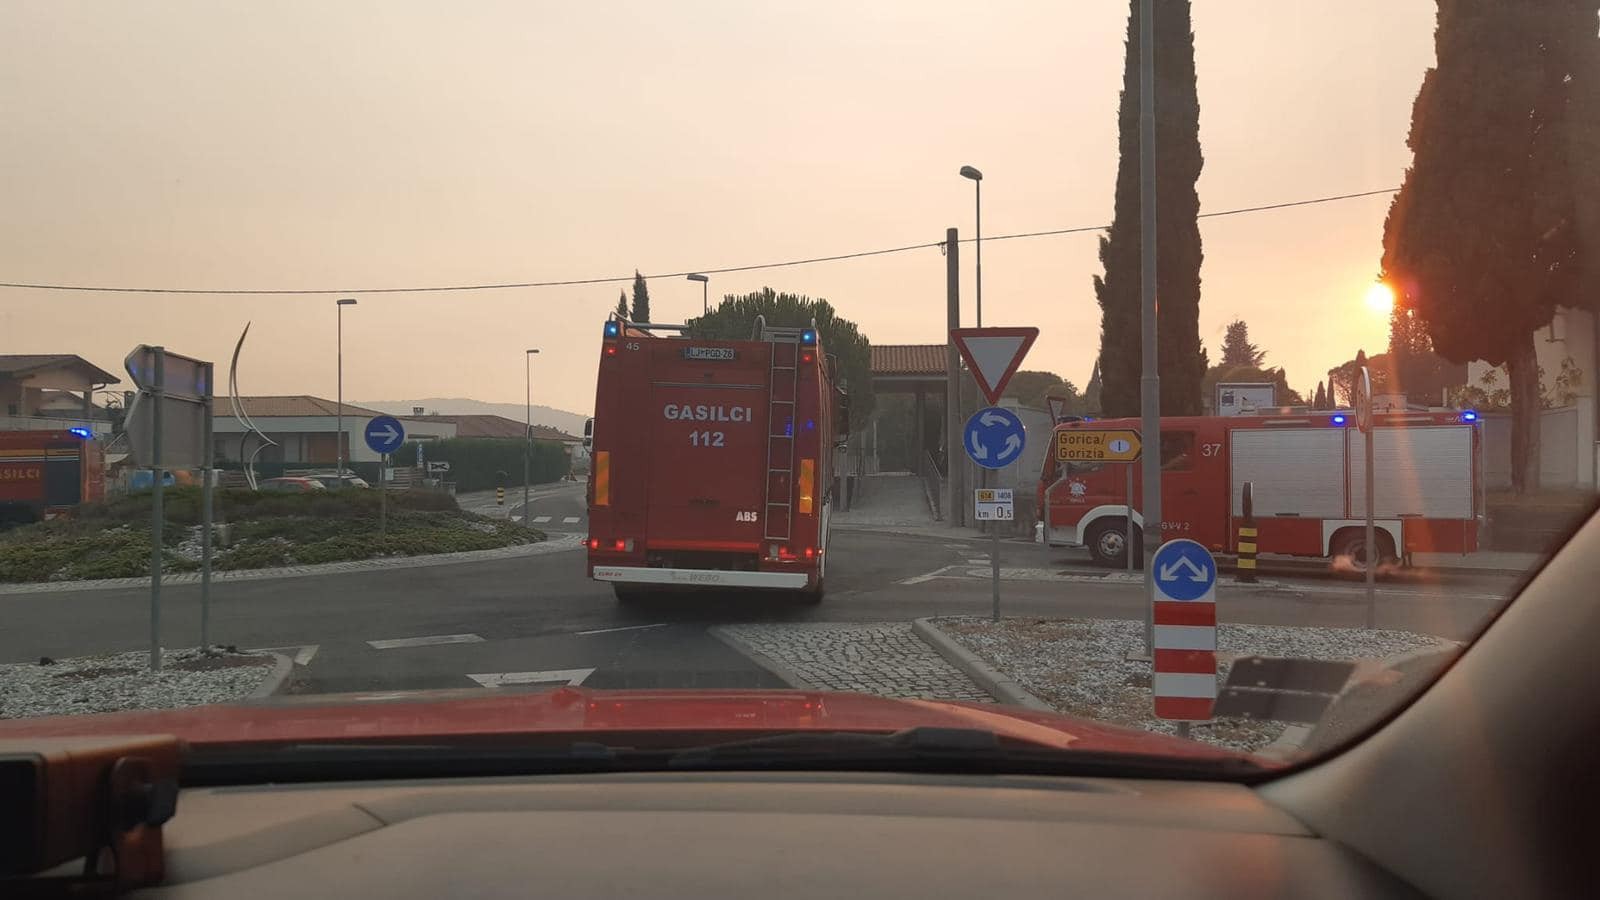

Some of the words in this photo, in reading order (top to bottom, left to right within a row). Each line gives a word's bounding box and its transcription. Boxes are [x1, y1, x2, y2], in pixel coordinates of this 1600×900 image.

[664, 403, 753, 423] GASILCI
[689, 430, 725, 447] 112
[1060, 433, 1107, 446] Gorica/
[1060, 447, 1105, 459] Gorizia
[1202, 443, 1221, 457] 37
[735, 511, 758, 523] ABS
[977, 508, 989, 518] km
